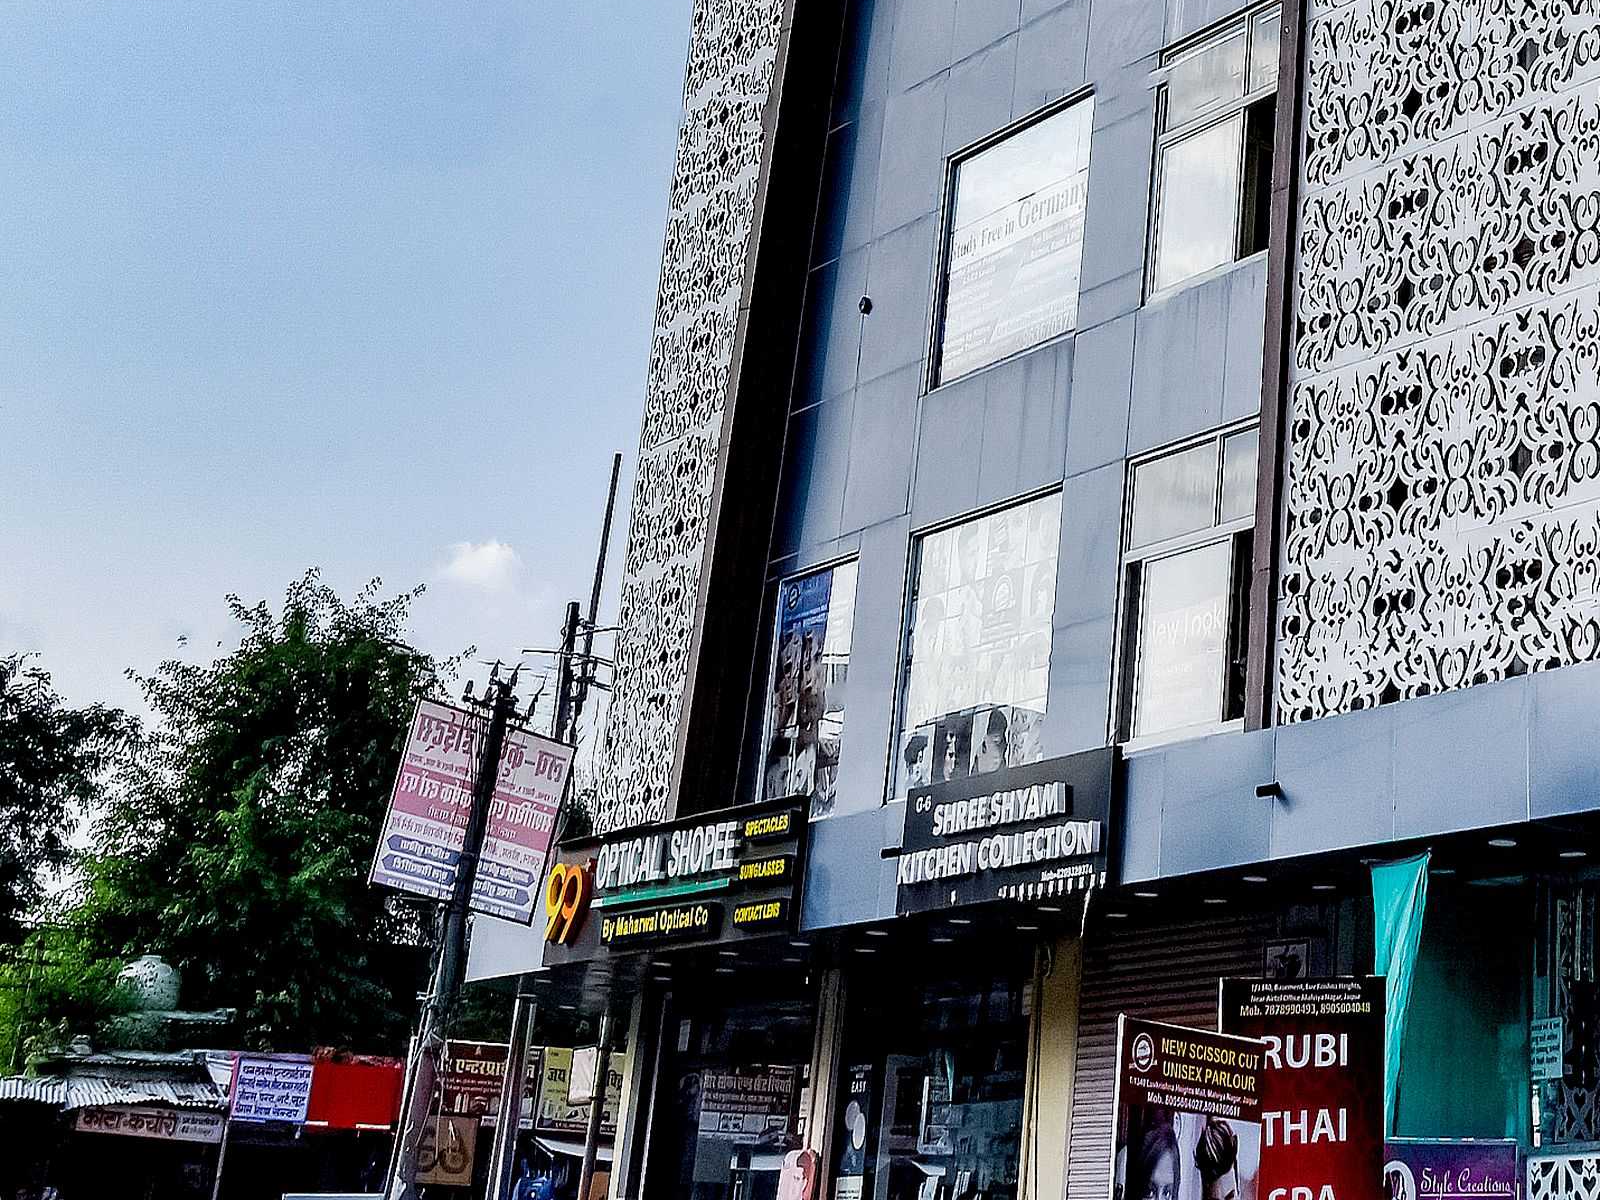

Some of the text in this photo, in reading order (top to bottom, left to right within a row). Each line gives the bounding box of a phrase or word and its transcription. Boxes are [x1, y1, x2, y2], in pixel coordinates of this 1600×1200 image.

[745, 814, 789, 837] SPECTACLES
[932, 781, 1066, 837] SHREE SHYAM
[596, 821, 738, 890] OPTICAL SHOPEE
[739, 858, 786, 881] SUNGLASSES
[897, 820, 1101, 886] KITCHEN COLLECTION
[602, 918, 615, 940] By
[616, 907, 659, 936] Maharwal
[660, 906, 695, 933] Optical
[734, 907, 763, 925] CONTACT
[1240, 1005, 1262, 1017] Mob.
[1161, 1038, 1260, 1070] NEW SCISSOR CUT
[1261, 1033, 1348, 1069] RUBI
[1162, 1061, 1256, 1092] UNISEX PARLOUR
[1261, 1108, 1347, 1147] THAI
[1420, 1167, 1511, 1200] Style Creations
